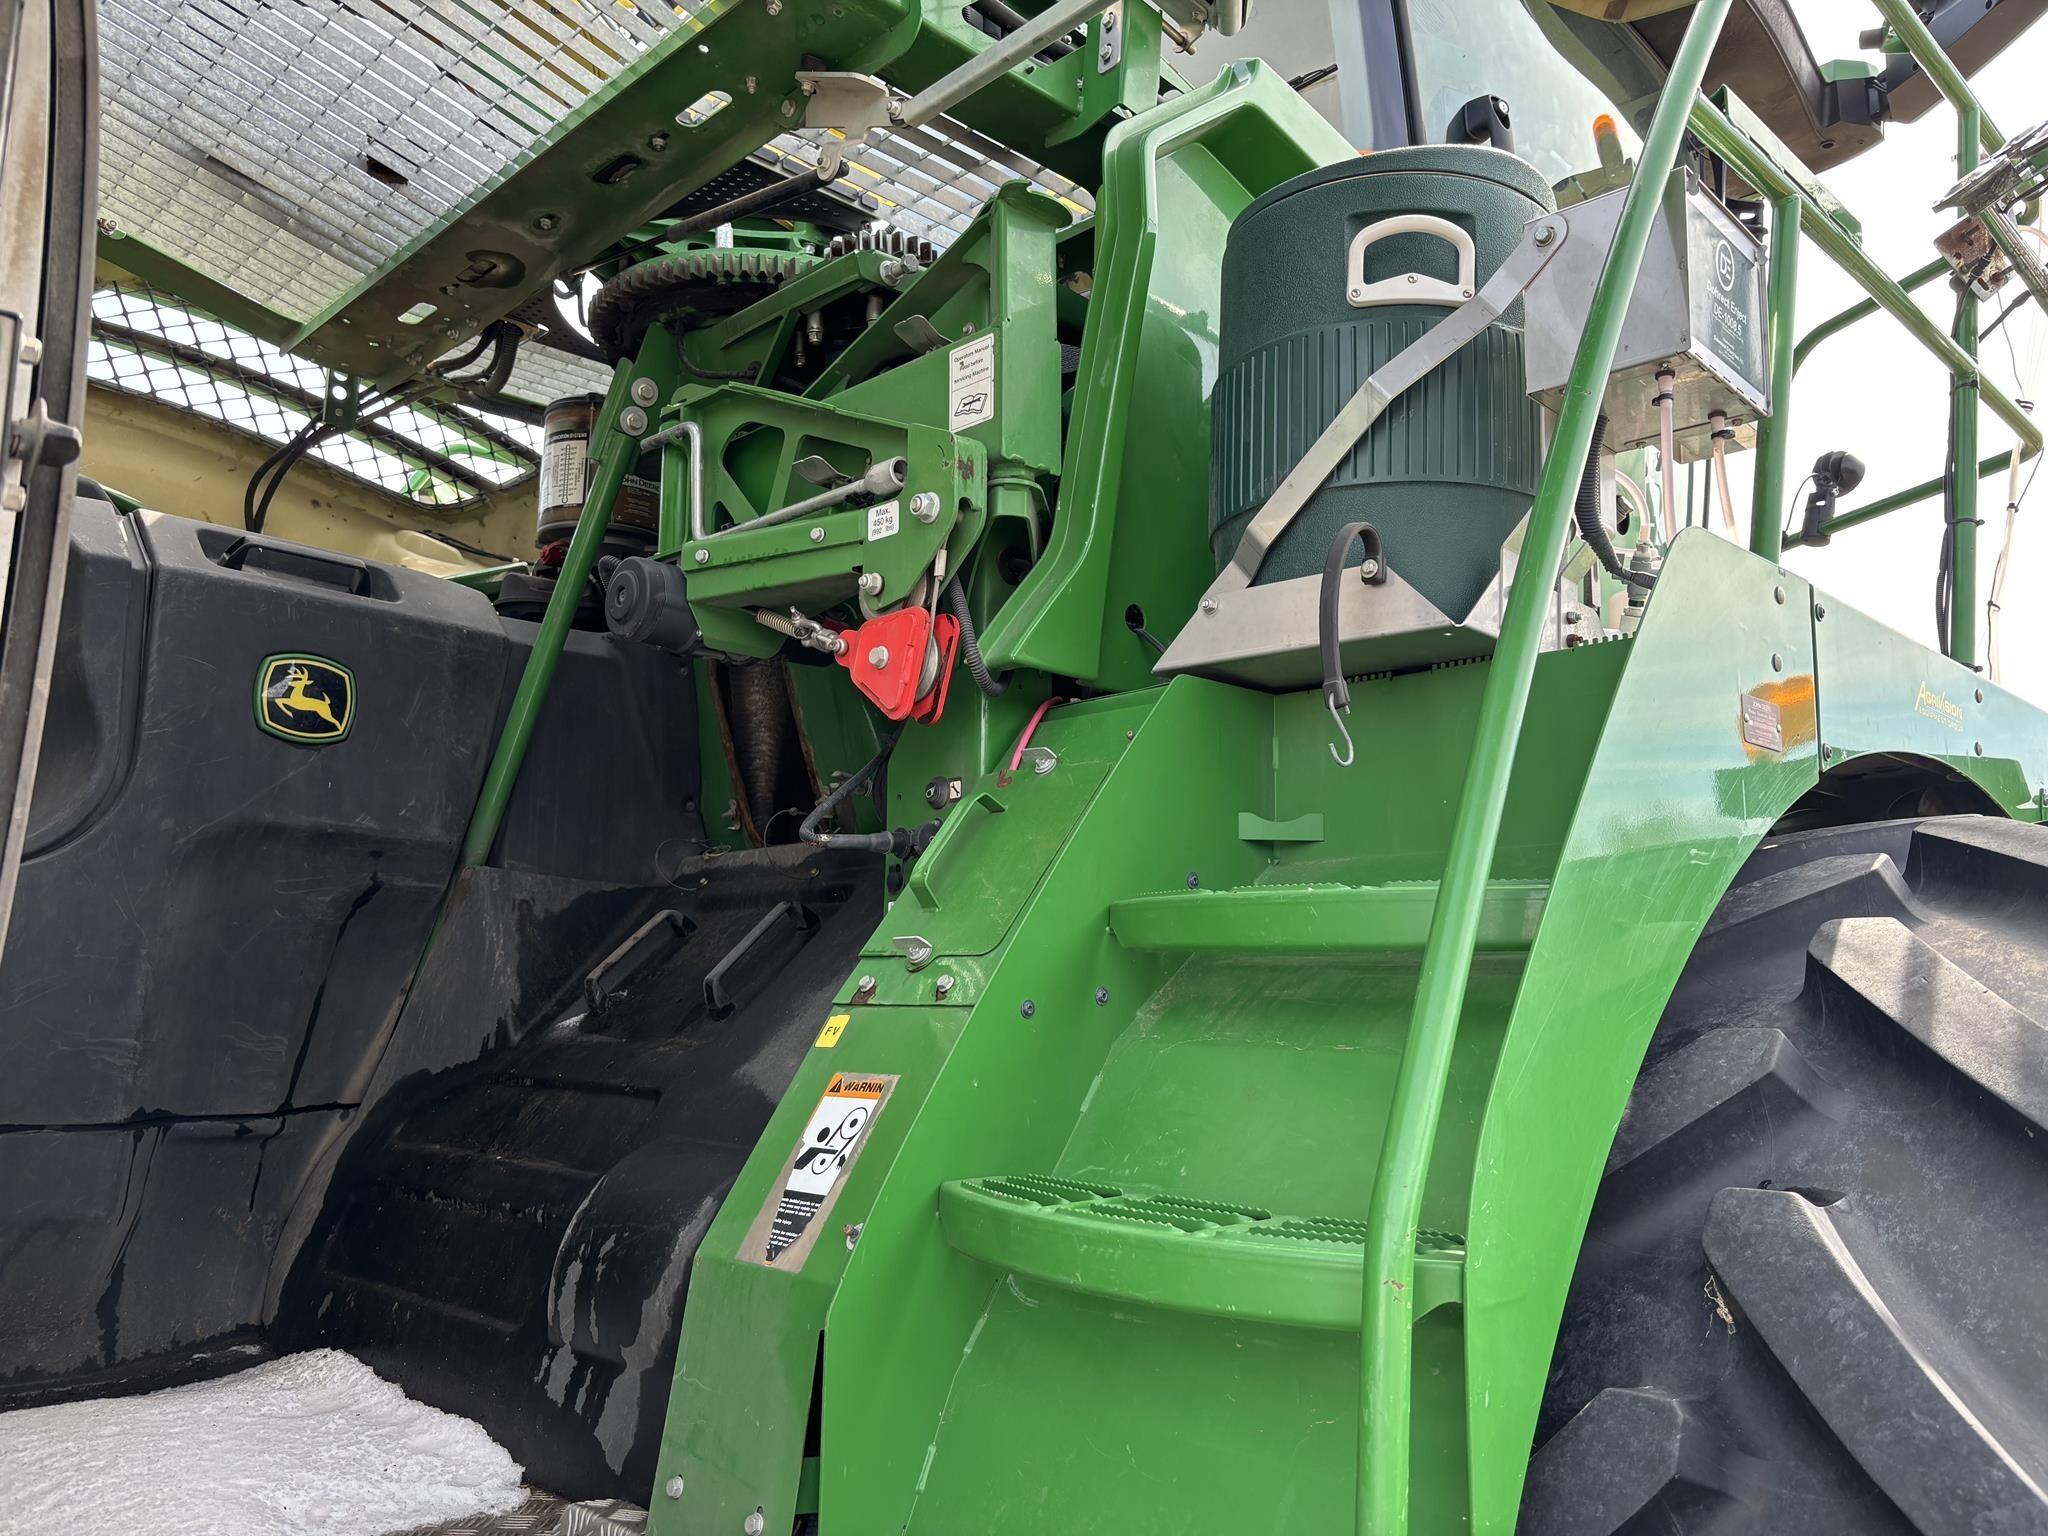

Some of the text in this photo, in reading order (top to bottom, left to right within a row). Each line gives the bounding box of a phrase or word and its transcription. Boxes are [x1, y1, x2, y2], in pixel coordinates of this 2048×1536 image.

[954, 344, 989, 363] Operators Manual
[970, 358, 984, 367] before
[972, 366, 989, 376] Machine
[875, 508, 891, 517] Max.
[873, 516, 893, 527] 450 kg
[825, 1026, 841, 1036] FV
